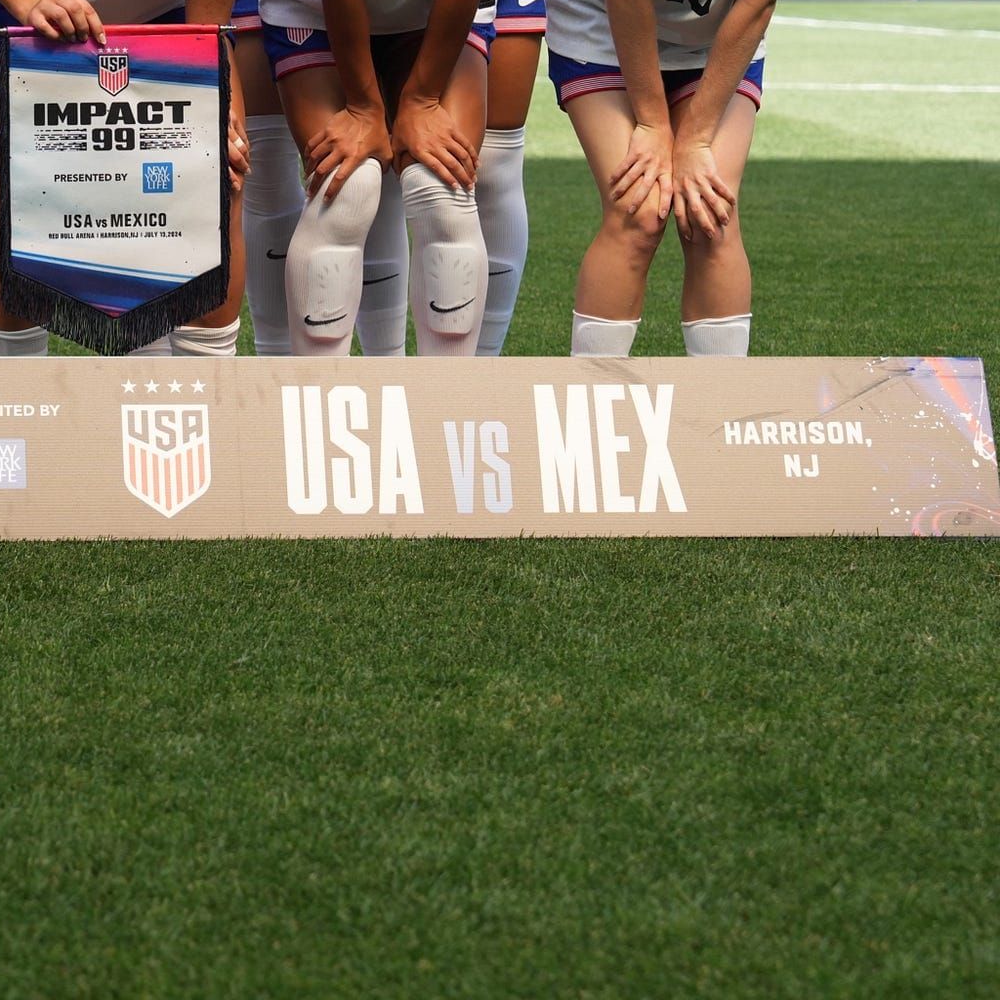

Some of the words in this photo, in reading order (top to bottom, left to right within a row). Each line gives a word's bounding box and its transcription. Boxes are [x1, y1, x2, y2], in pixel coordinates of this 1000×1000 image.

[100, 57, 127, 72] USA
[34, 101, 192, 126] IMPACT
[92, 127, 136, 151] 99
[54, 173, 112, 182] PRESENTED
[115, 173, 128, 182] BY
[147, 166, 169, 174] NEW
[144, 174, 170, 182] YORK
[147, 181, 168, 190] LIFE
[64, 214, 93, 228] USA
[110, 213, 167, 228] MEXICO
[40, 404, 60, 417] BY
[127, 410, 204, 452] USA
[724, 421, 873, 448] HARRISON,
[281, 385, 425, 514] USA
[443, 421, 513, 513] VS
[533, 384, 688, 513] MEX
[784, 454, 820, 478] NJ
